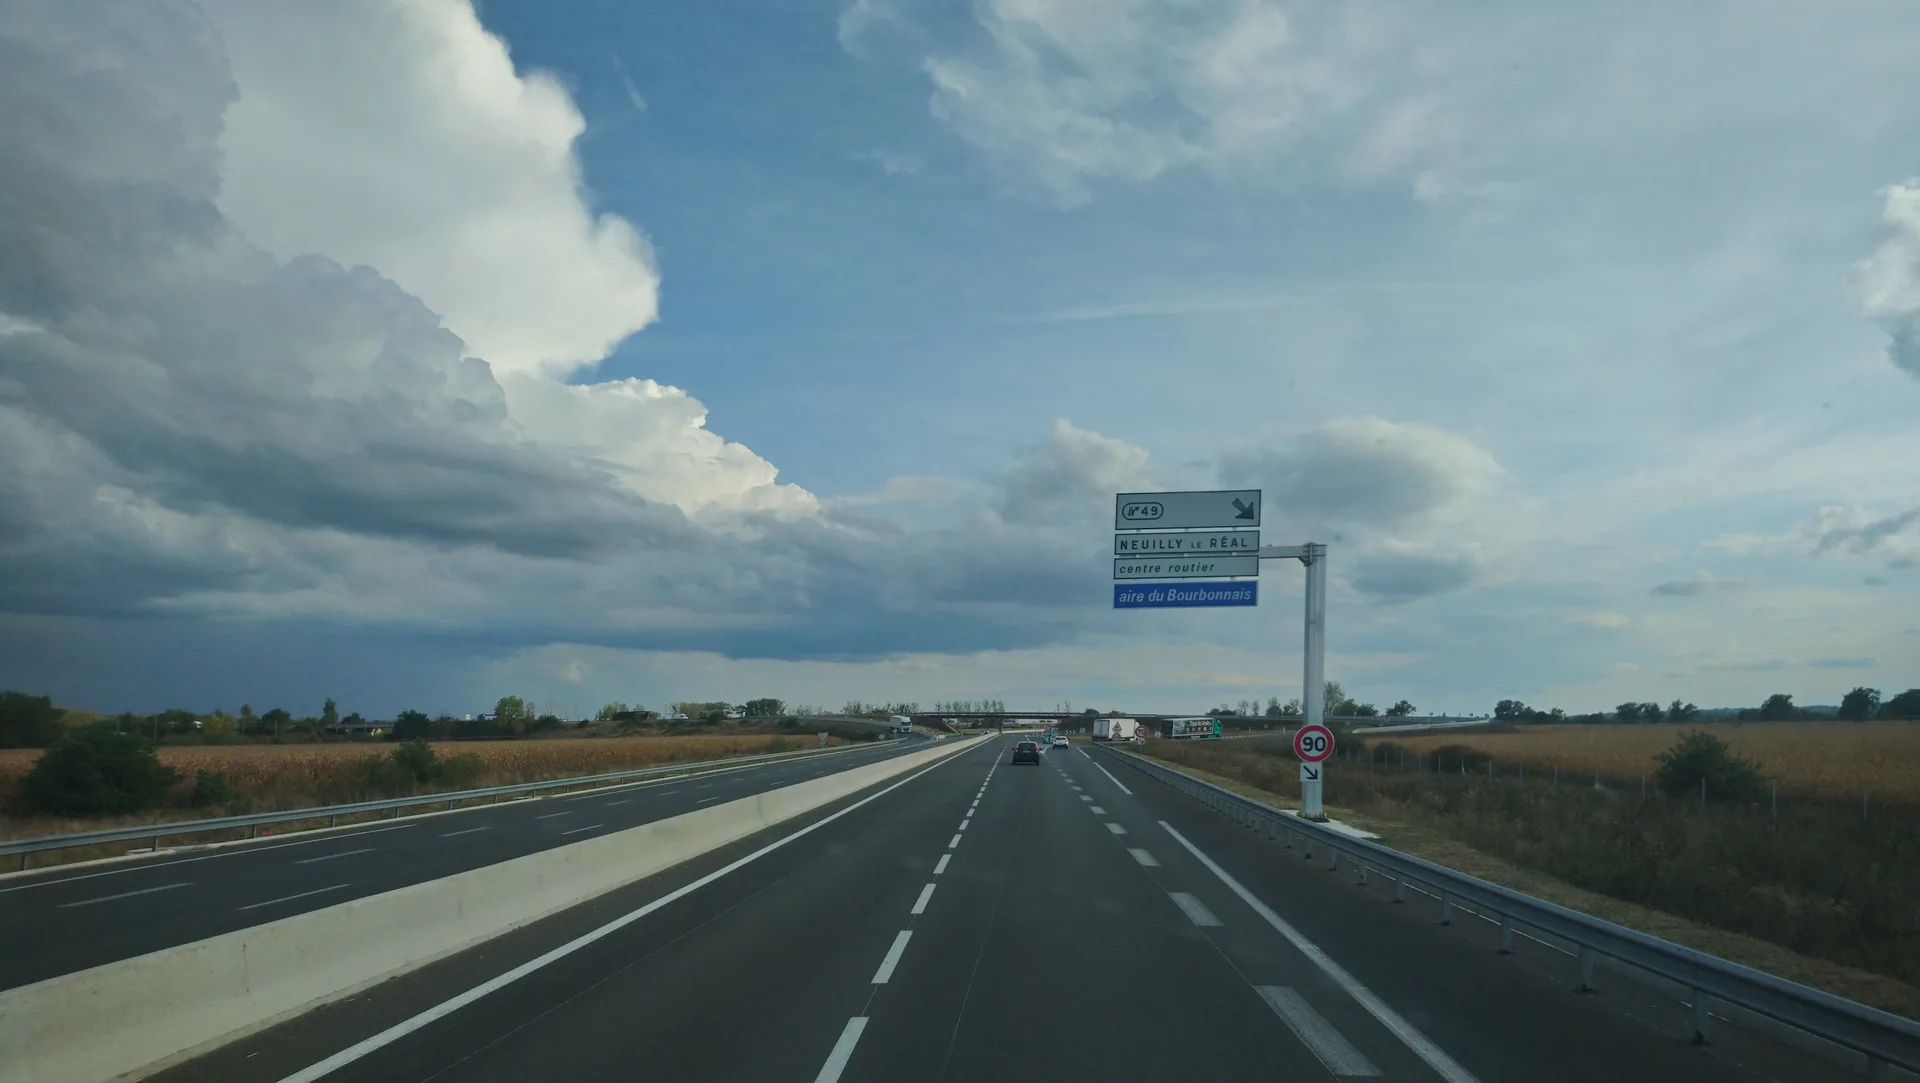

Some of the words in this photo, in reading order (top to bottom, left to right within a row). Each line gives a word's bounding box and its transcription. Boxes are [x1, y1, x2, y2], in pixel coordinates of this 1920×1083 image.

[1120, 539, 1183, 550] NEUILLY
[1191, 541, 1202, 549] LE
[1210, 536, 1248, 548] RÉAL
[1119, 563, 1161, 574] centre
[1168, 562, 1215, 573] routier
[1119, 590, 1145, 603] aire
[1148, 589, 1164, 602] du
[1167, 587, 1252, 601] Bourbonnais
[1302, 736, 1327, 752] 90
